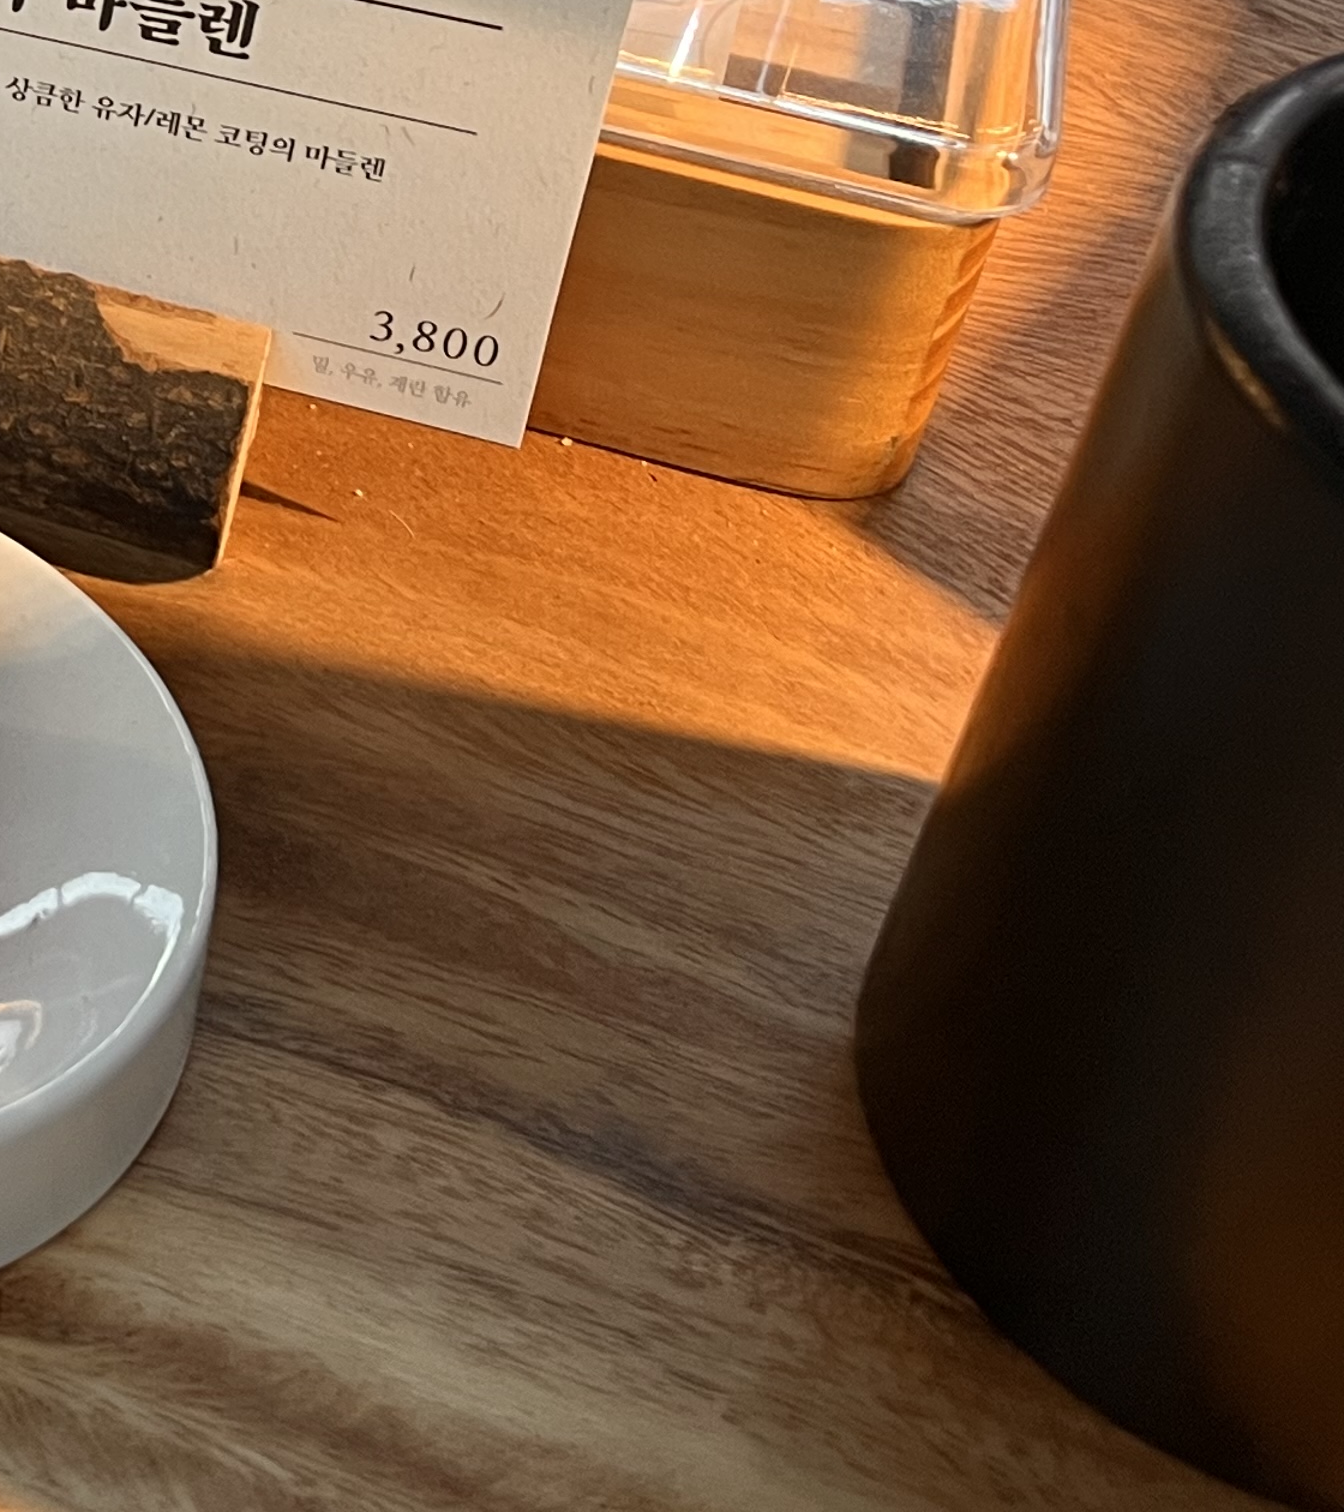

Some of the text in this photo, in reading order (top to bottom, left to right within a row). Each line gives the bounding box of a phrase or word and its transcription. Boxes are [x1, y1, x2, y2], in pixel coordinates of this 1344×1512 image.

[5, 77, 85, 115] 상큼한
[92, 96, 207, 143] 유자/레몬
[214, 124, 296, 163] 코팅의
[305, 145, 386, 183] 마들렌
[369, 310, 499, 367] 3,800
